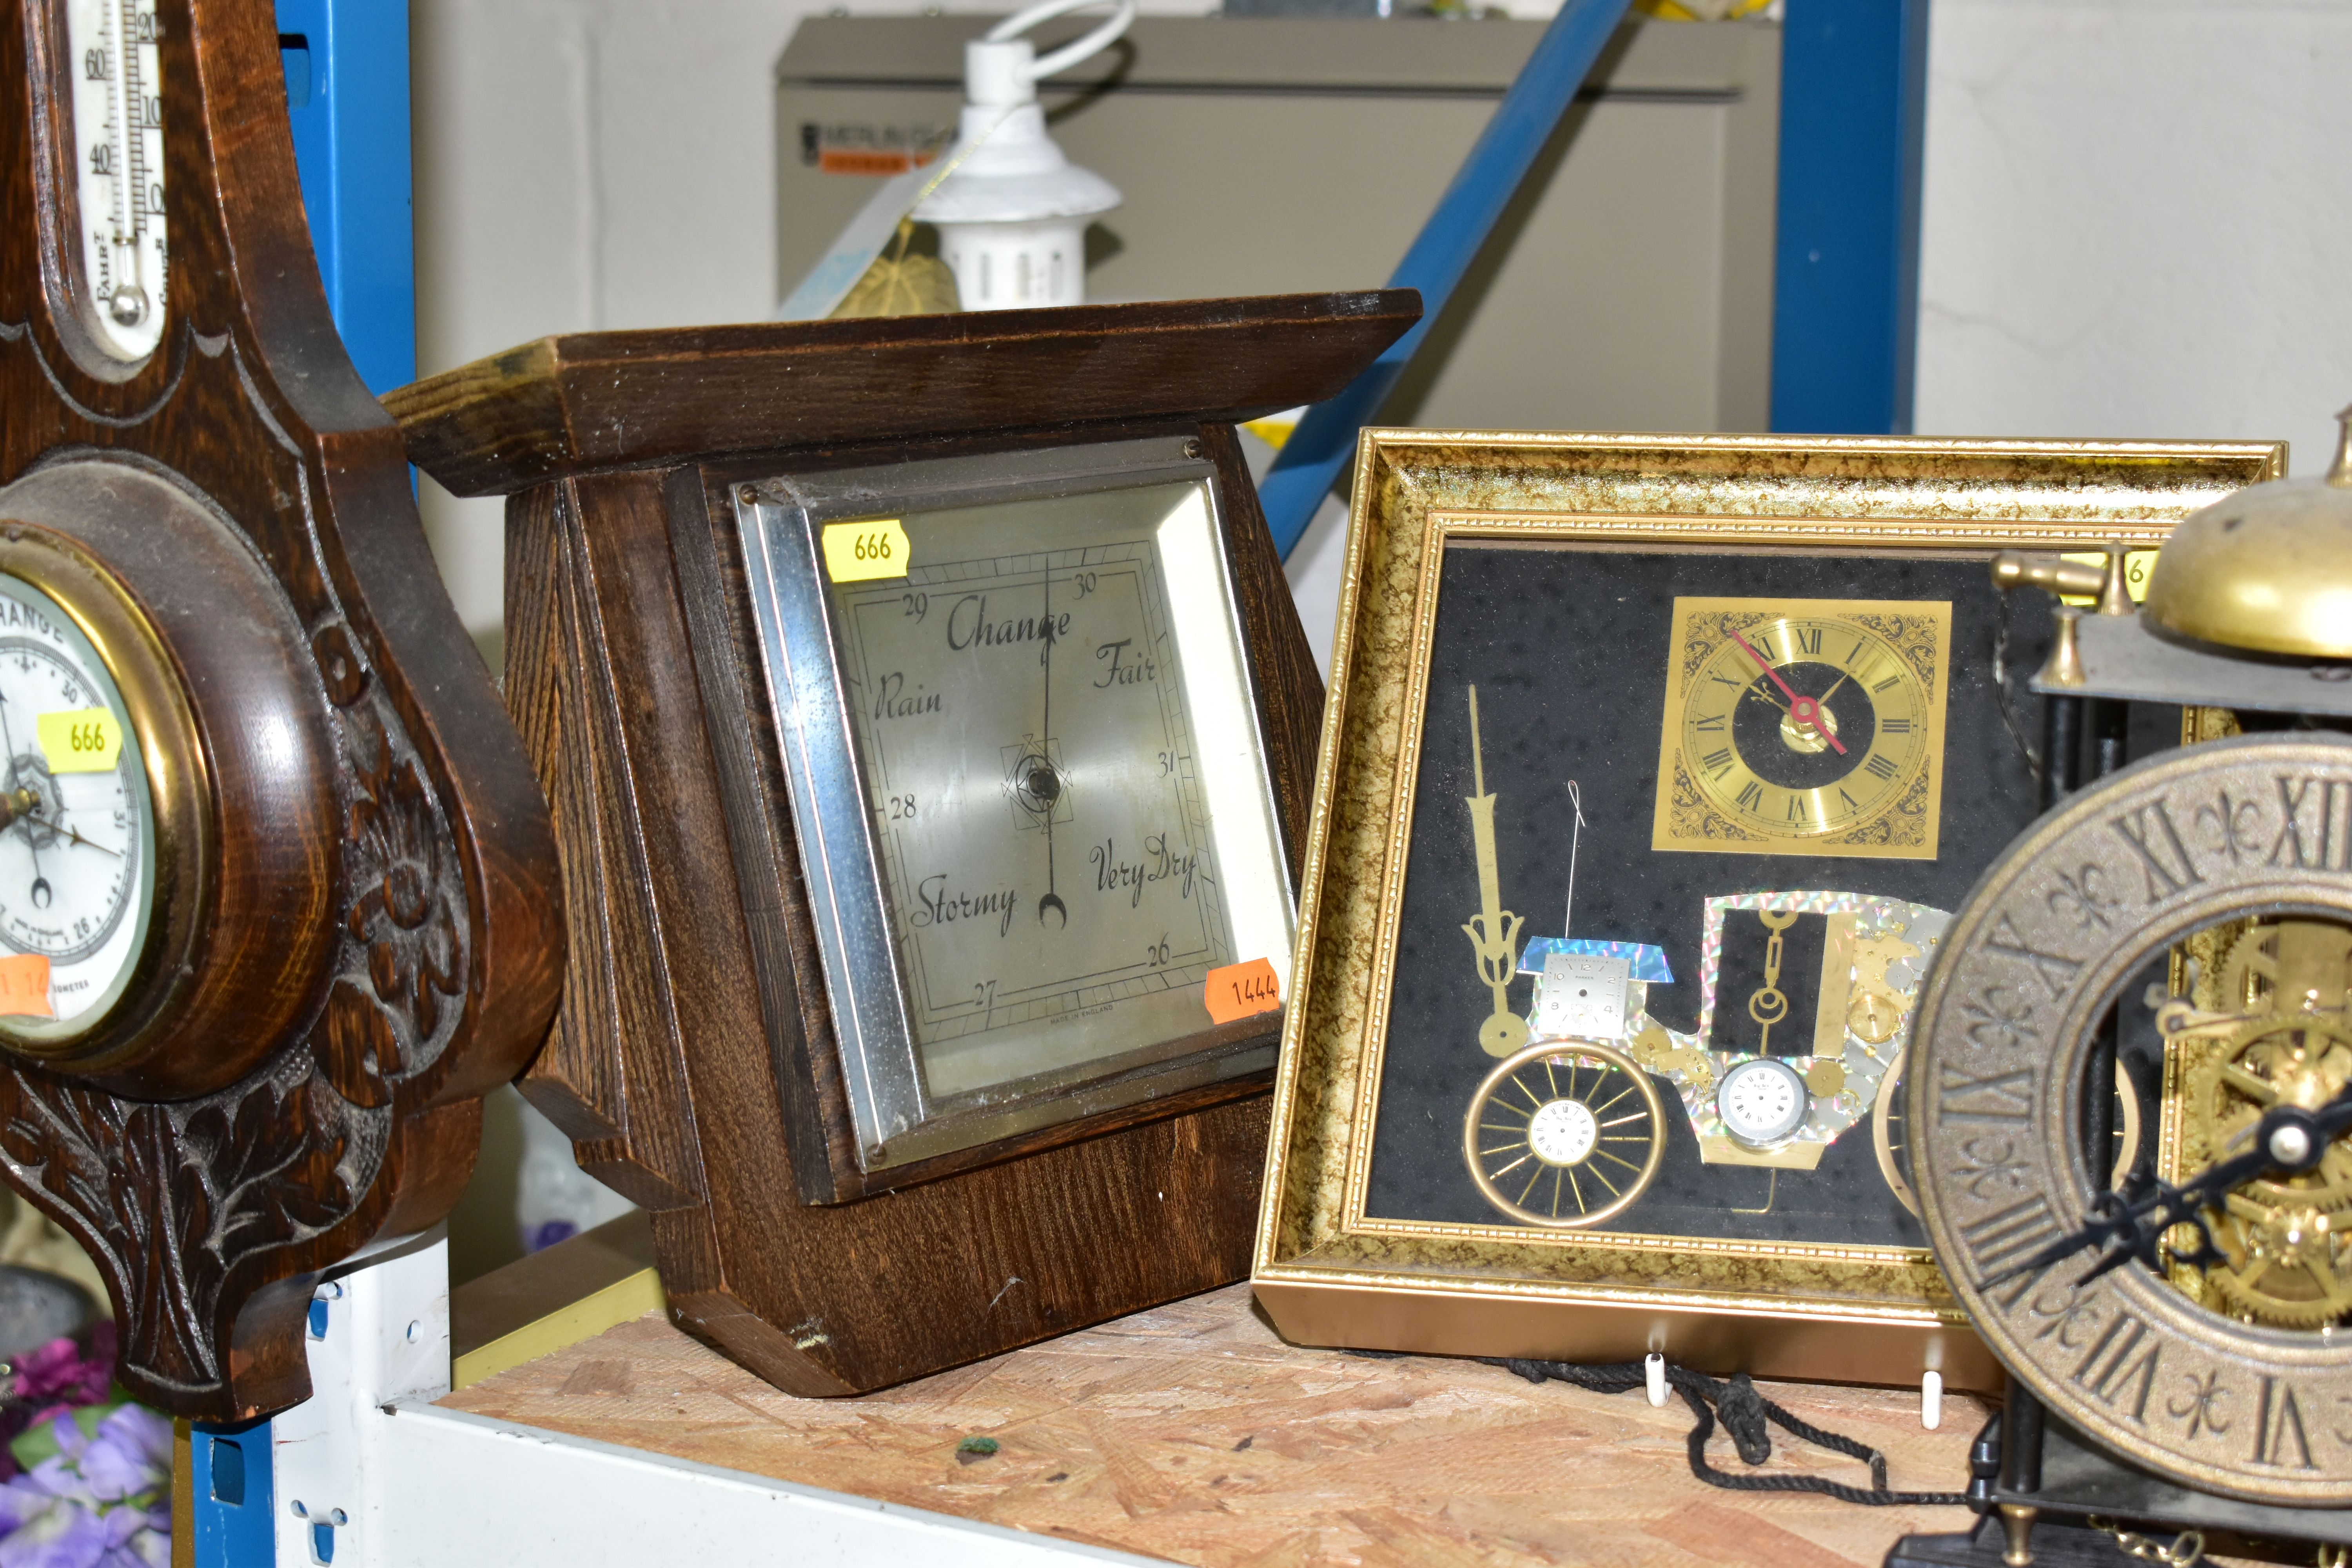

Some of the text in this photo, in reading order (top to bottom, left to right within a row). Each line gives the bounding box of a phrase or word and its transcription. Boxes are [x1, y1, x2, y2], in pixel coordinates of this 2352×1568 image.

[138, 13, 157, 40] 20
[85, 49, 105, 77] 60
[143, 96, 161, 125] 10
[89, 143, 111, 172] 40
[151, 183, 164, 212] 0
[855, 533, 891, 561] 666
[1072, 572, 1096, 600] 30
[903, 593, 928, 625] 29
[947, 595, 1071, 667] Change
[1796, 629, 1822, 655] XII
[1093, 638, 1156, 688] Fair
[62, 680, 78, 704] 30
[875, 671, 943, 720] Rain
[1711, 670, 1742, 693] X
[1872, 674, 1901, 693] II
[71, 722, 105, 751] 666
[1697, 713, 1726, 732] IX
[1882, 719, 1910, 733] III
[1156, 750, 1174, 778] 31
[1702, 747, 1736, 782] VIII
[1864, 753, 1899, 782] IIII
[891, 794, 916, 820] 28
[1735, 780, 1763, 813] VII
[1787, 795, 1808, 821] VI
[1838, 787, 1859, 812] V
[2108, 796, 2207, 905] XI
[1090, 832, 1197, 908] Very Dry
[911, 874, 1018, 938] Stormy
[73, 917, 90, 940] 26
[1147, 932, 1169, 967] 26
[1983, 909, 2087, 1004] X
[975, 980, 997, 1007] 27
[1232, 975, 1276, 1005] 1444
[1051, 1015, 1069, 1024] MADE
[1082, 1005, 1113, 1017] ENGLAND
[1551, 1002, 1559, 1010] 8
[1939, 1060, 2037, 1128] IX
[2071, 1308, 2164, 1428] VII
[2243, 1371, 2322, 1472] VI
